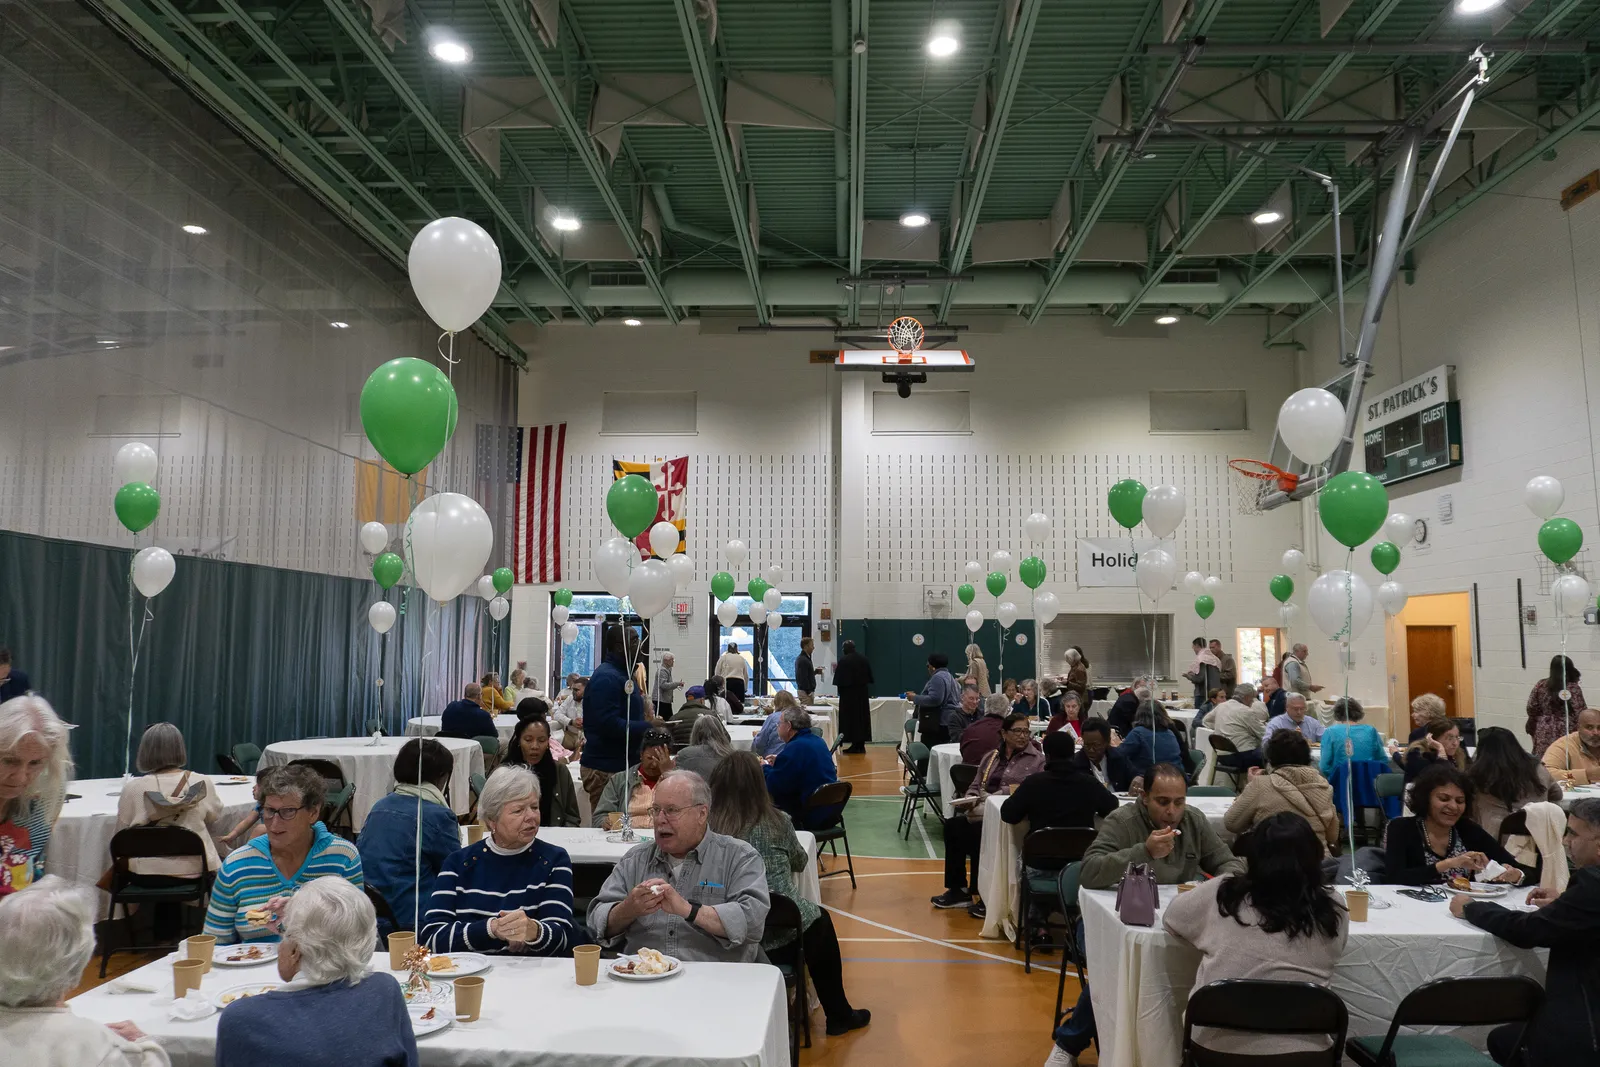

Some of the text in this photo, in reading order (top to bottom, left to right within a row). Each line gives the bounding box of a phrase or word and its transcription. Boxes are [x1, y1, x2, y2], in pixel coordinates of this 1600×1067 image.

[1368, 376, 1438, 421] ST. PATRICK'S
[1422, 405, 1445, 424] GUEST
[1365, 430, 1382, 447] HOME
[1422, 457, 1437, 468] BONUS
[1092, 552, 1138, 567] Holid
[676, 603, 688, 612] EXIT
